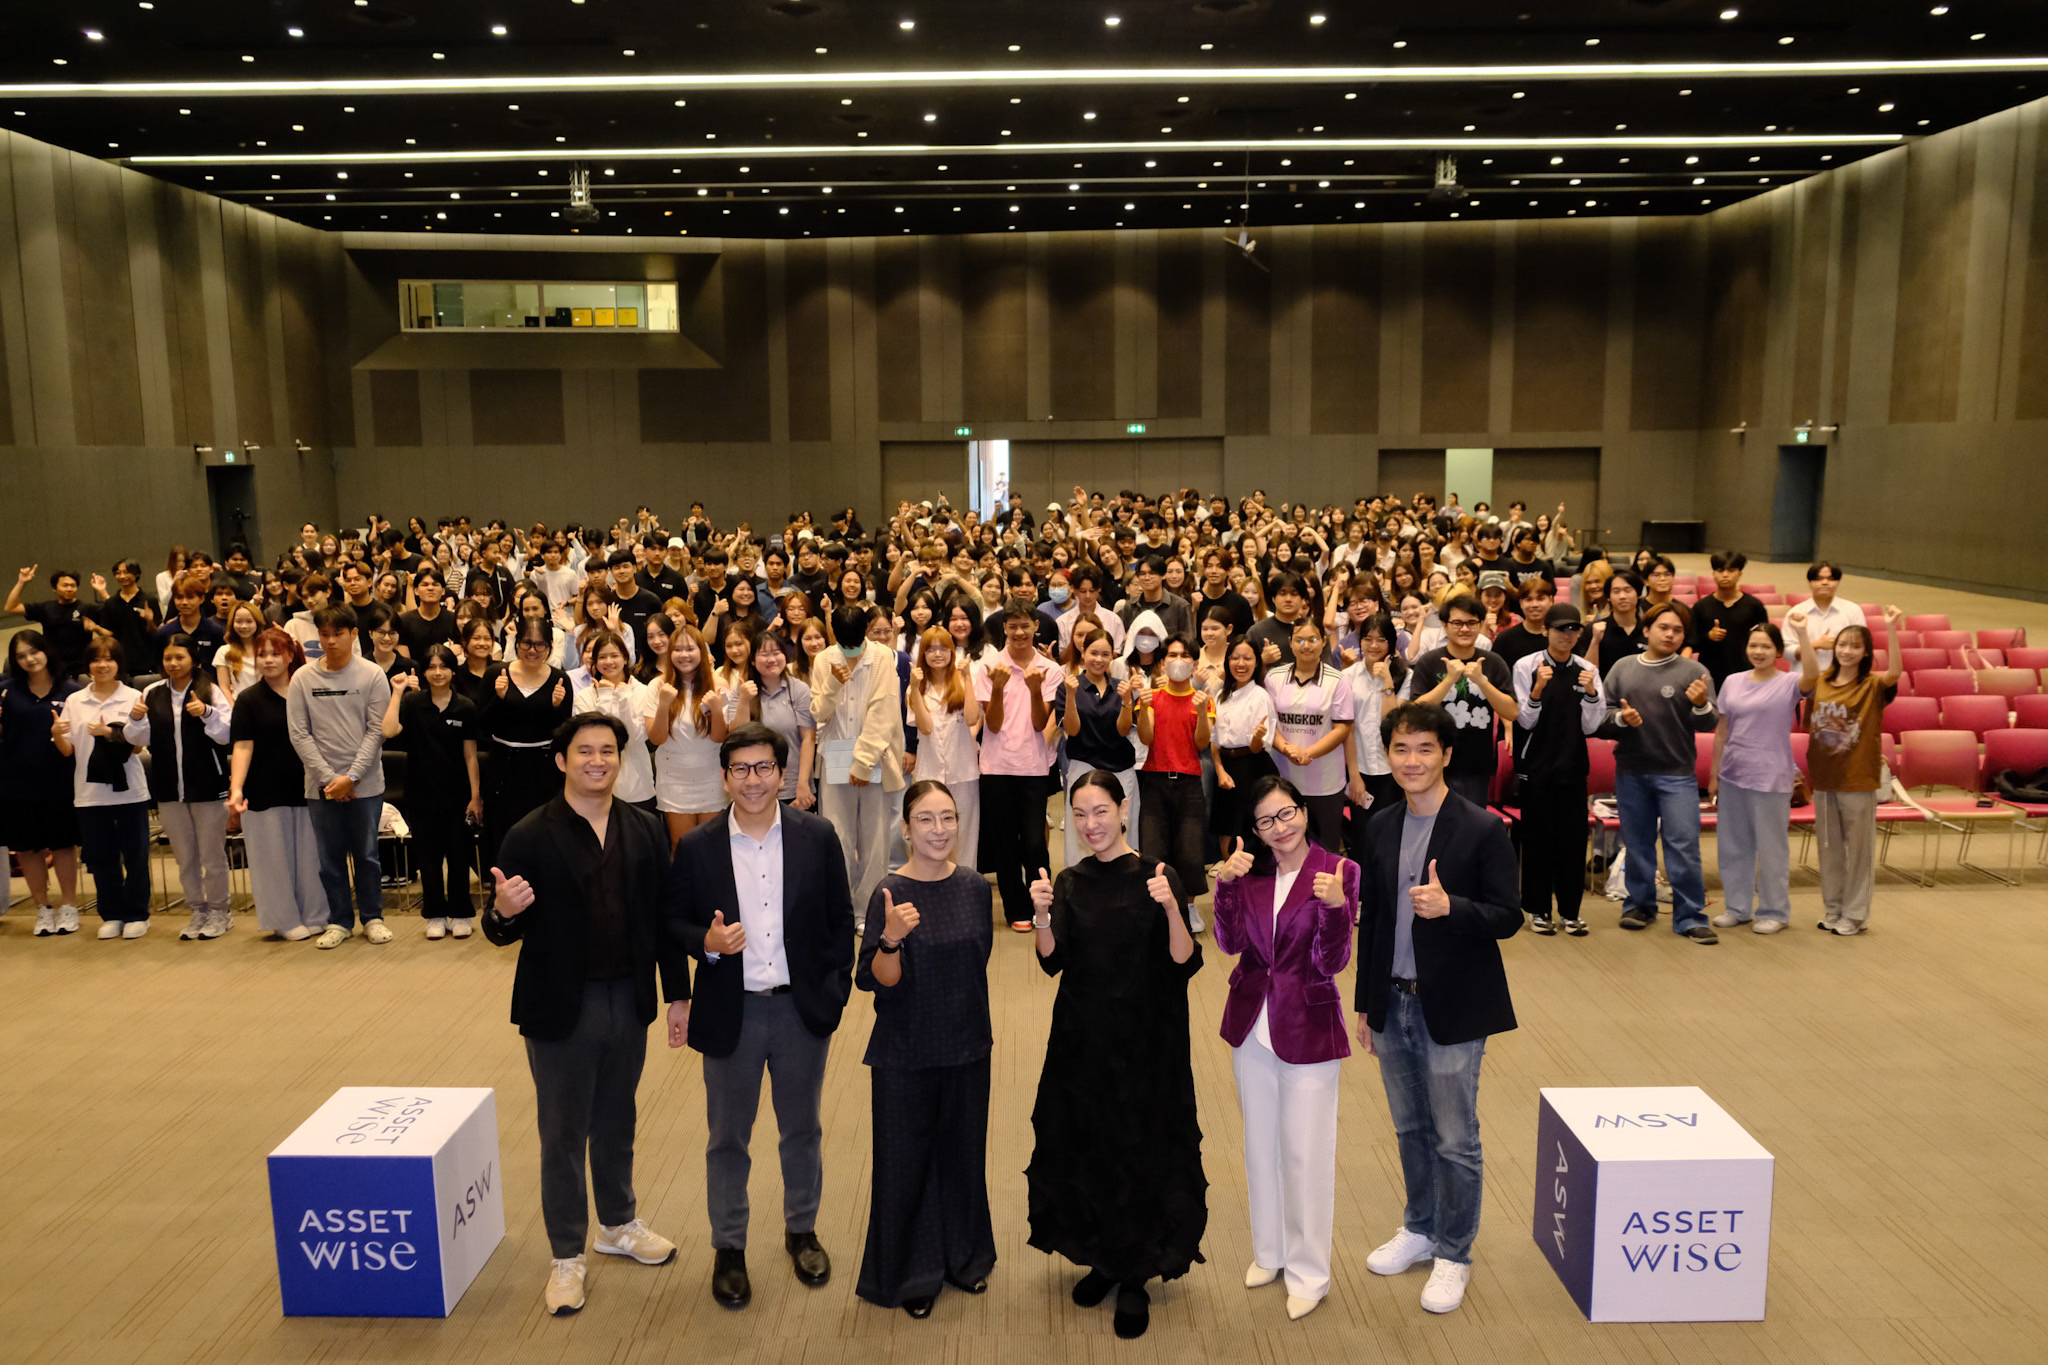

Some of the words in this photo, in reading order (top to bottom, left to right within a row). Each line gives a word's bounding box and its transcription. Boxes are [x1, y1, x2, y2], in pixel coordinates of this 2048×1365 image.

[335, 1097, 405, 1144] Wise
[374, 1097, 432, 1144] ASSET
[1594, 1112, 1698, 1129] ASW
[452, 1161, 492, 1240] ASW
[1553, 1140, 1569, 1260] ASW
[298, 1209, 413, 1234] ASSET
[1621, 1210, 1745, 1235] ASSET
[299, 1241, 418, 1271] Wise
[1621, 1242, 1742, 1273] Wise
